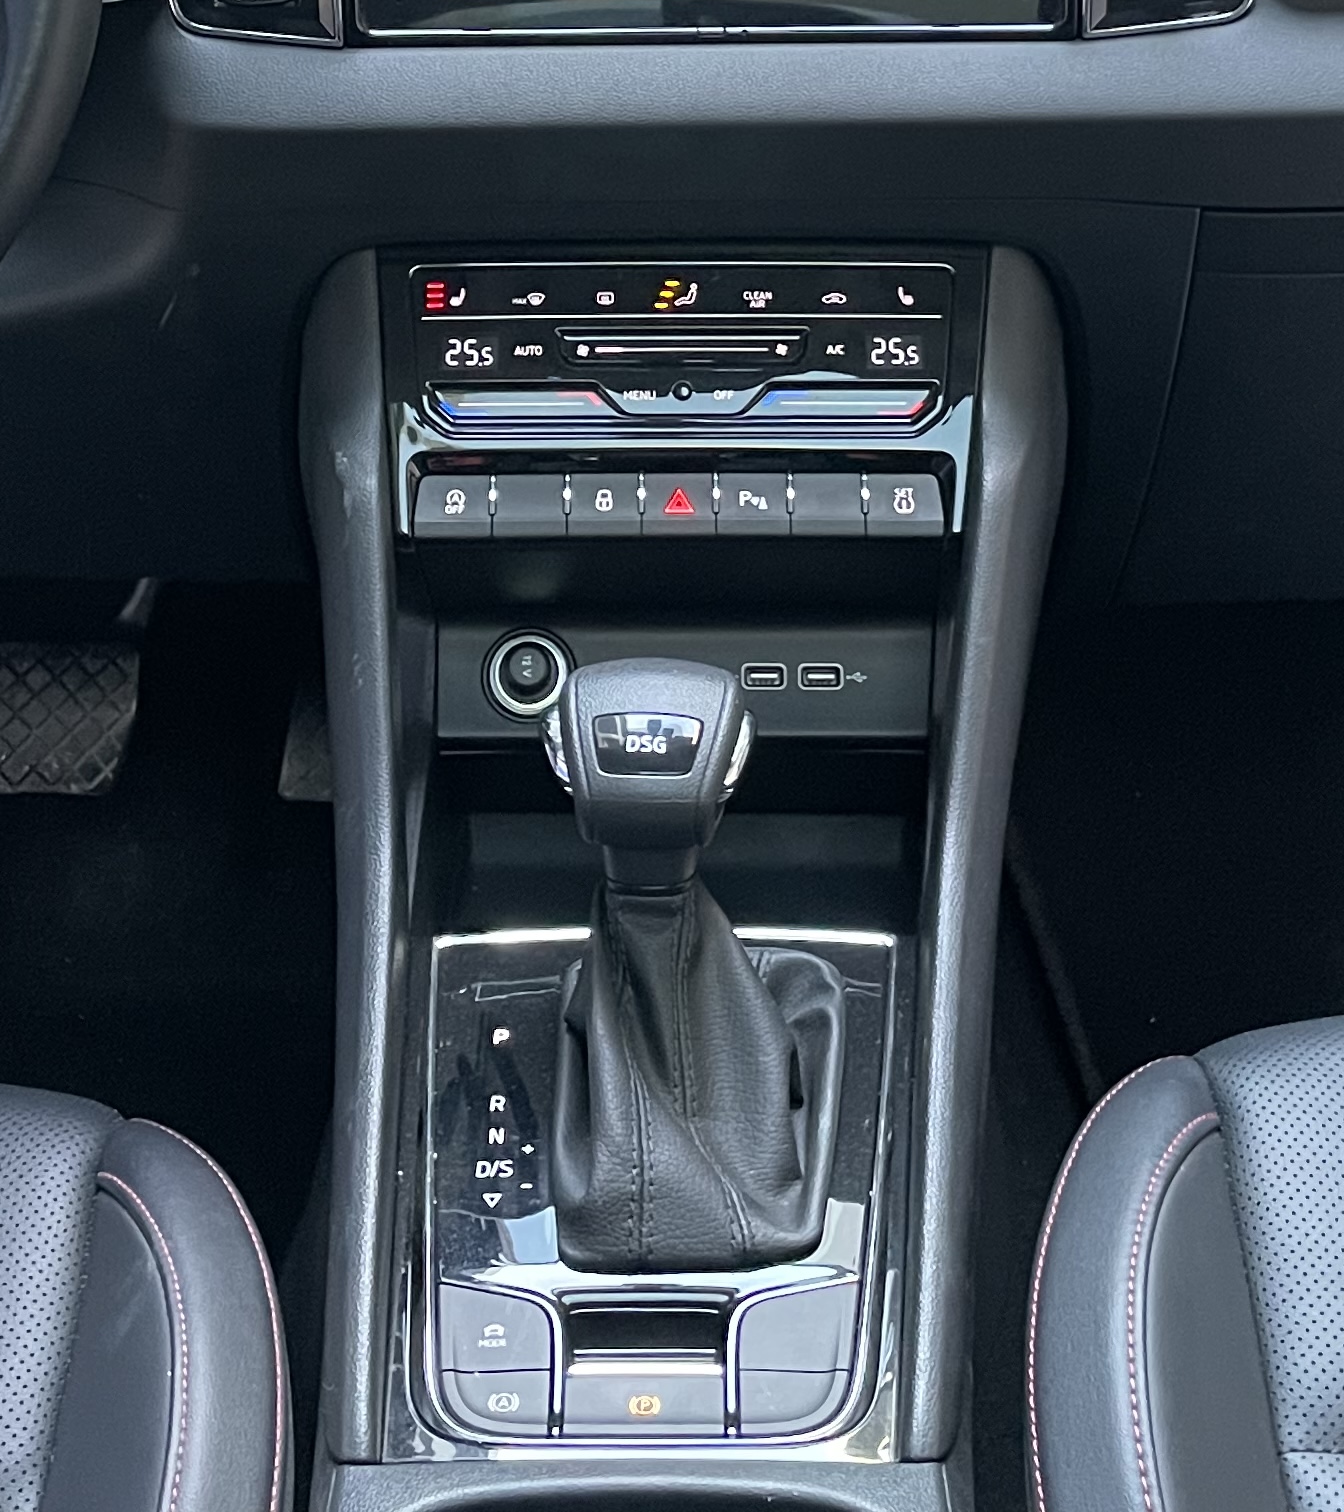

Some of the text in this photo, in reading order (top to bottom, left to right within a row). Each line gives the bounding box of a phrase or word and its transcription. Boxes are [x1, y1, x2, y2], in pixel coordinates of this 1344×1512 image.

[742, 290, 773, 301] CLEAN
[444, 338, 495, 367] 25.5
[513, 345, 544, 357] AUTO
[825, 344, 846, 356] A/C
[869, 337, 921, 366] 25.5
[622, 389, 657, 401] MENU
[713, 389, 734, 401] OFF
[625, 734, 667, 754] DSG
[492, 1028, 510, 1045] P
[489, 1094, 507, 1112] R
[488, 1127, 505, 1145] N
[474, 1159, 514, 1178] D/S
